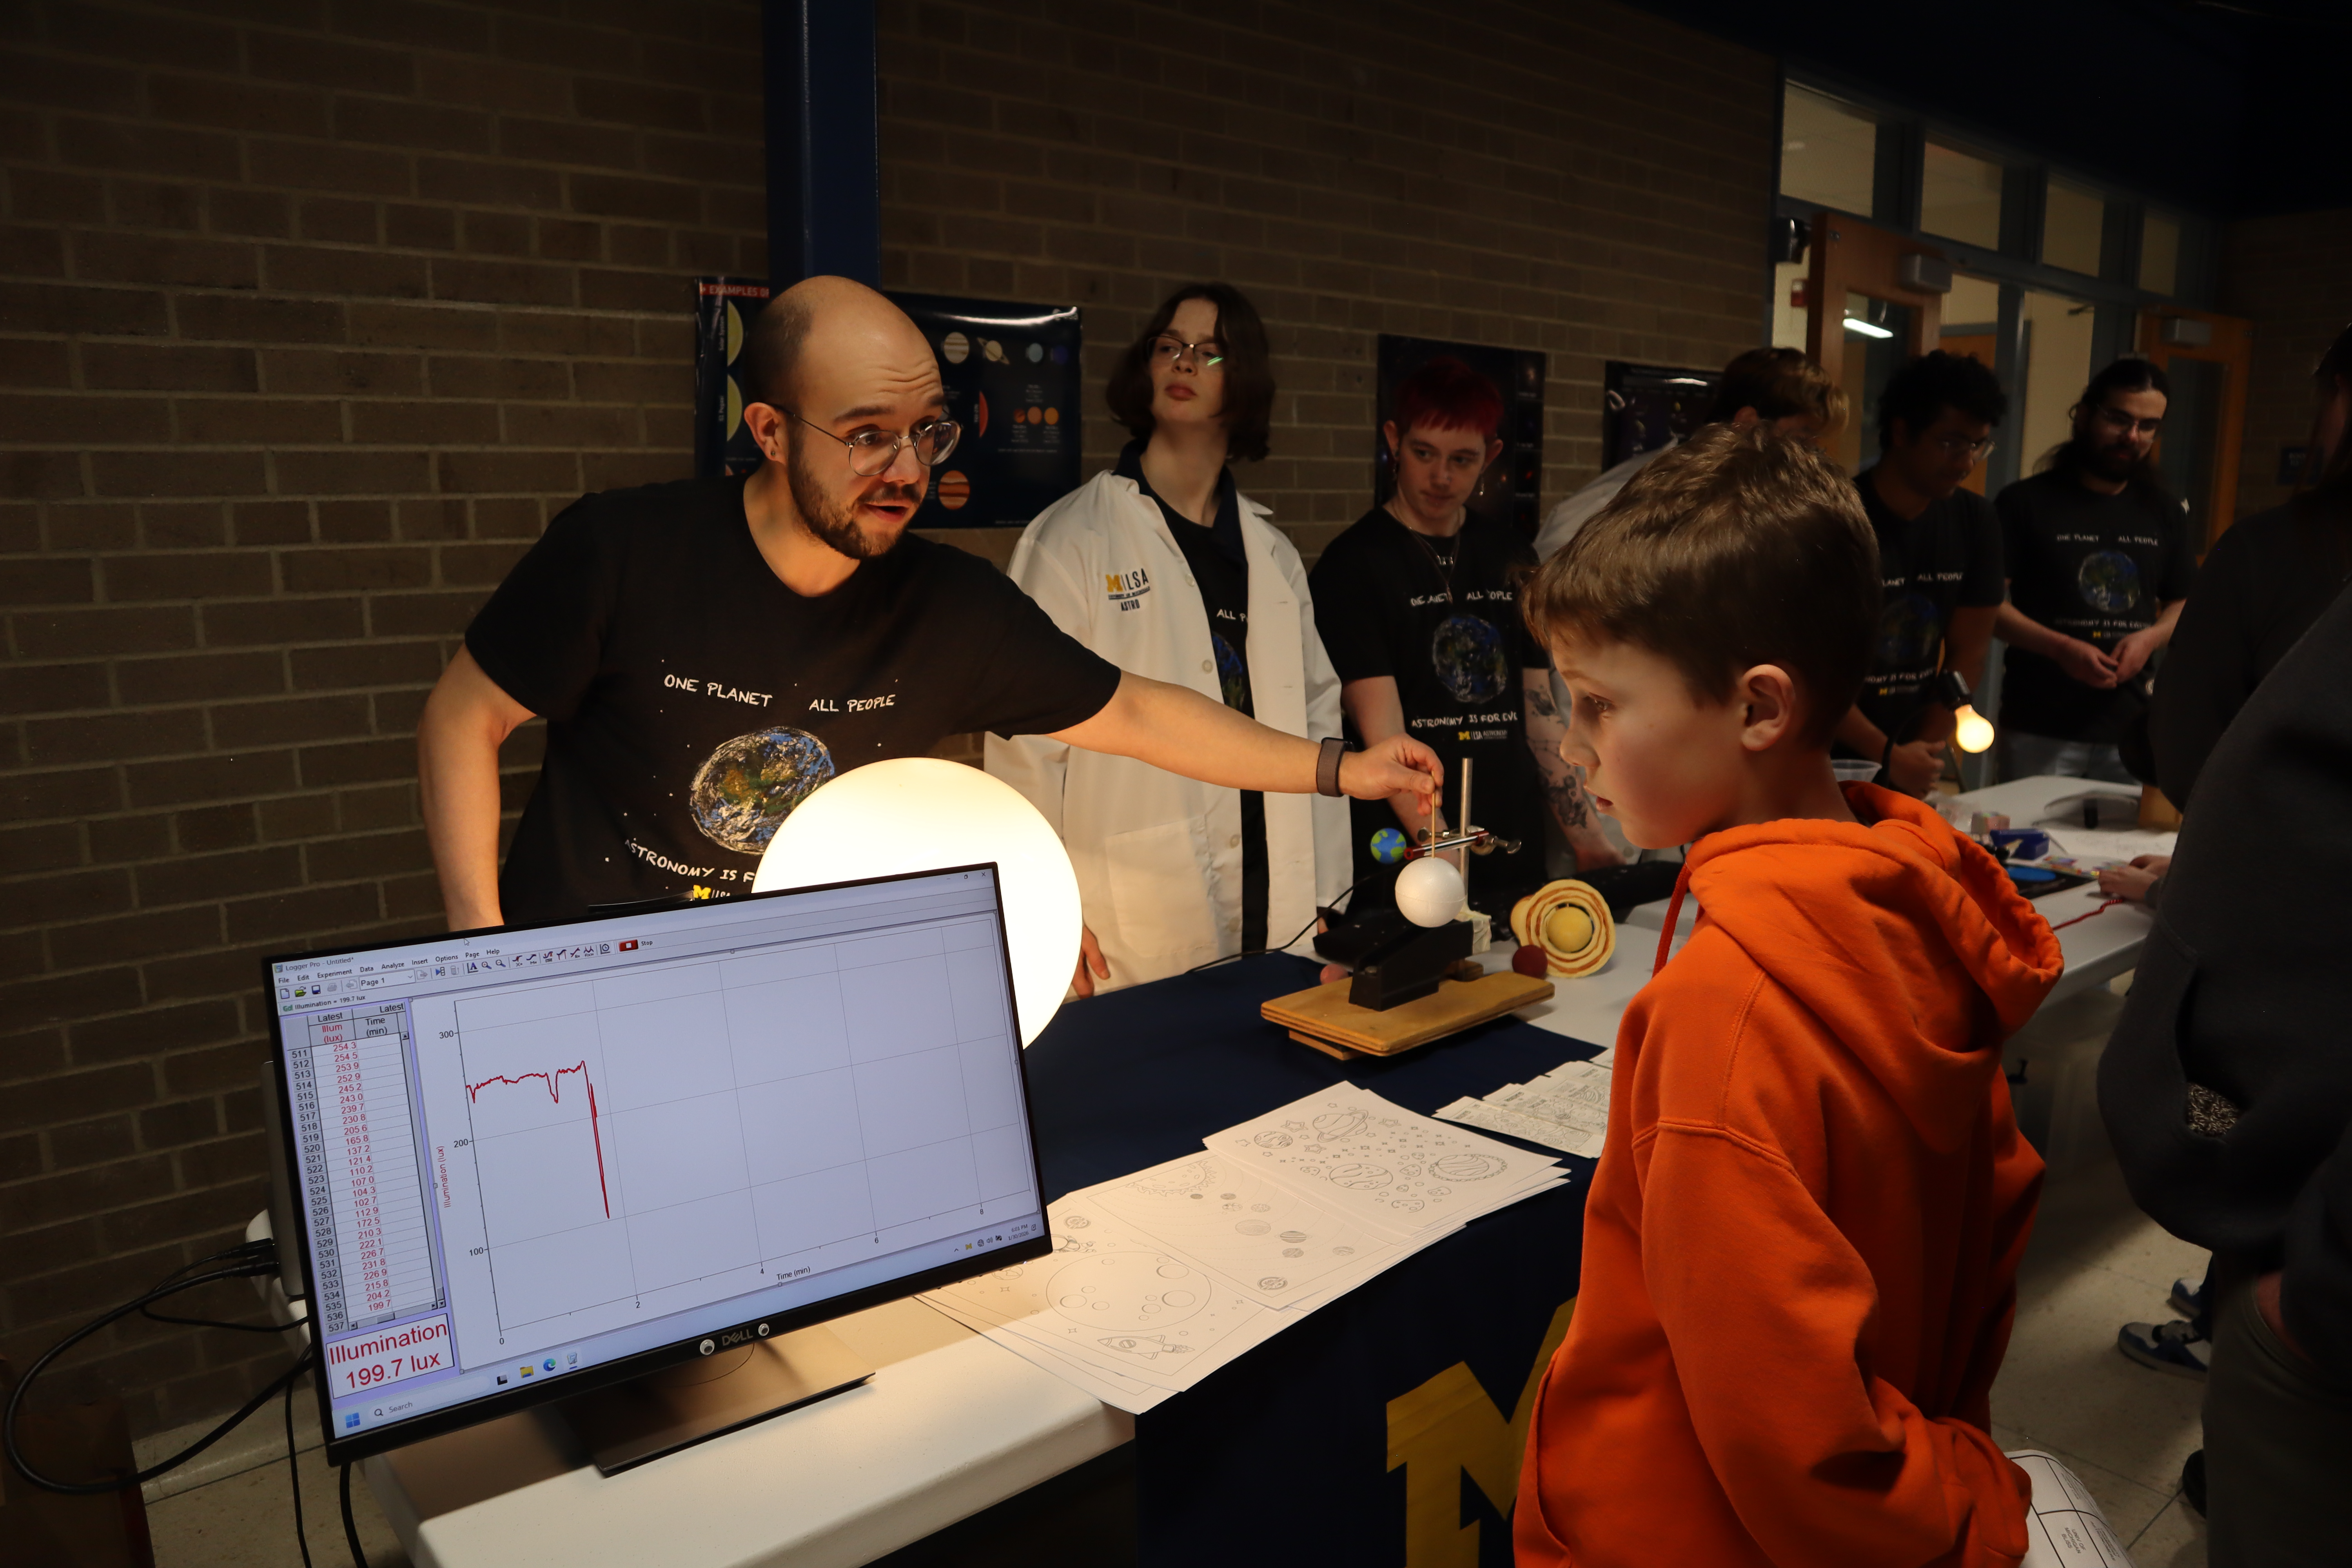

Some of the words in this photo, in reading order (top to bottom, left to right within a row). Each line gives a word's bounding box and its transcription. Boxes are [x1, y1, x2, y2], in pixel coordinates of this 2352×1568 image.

[709, 285, 758, 296] EXAMPLES
[2056, 533, 2071, 542] ONE
[2073, 533, 2100, 543] PLANET
[2118, 535, 2131, 543] ALL
[2134, 535, 2158, 546] PEOPLE
[1105, 574, 1123, 592] M
[1126, 568, 1149, 590] LSA
[1882, 577, 1906, 587] LANET
[1917, 573, 1934, 582] ALL
[1121, 599, 1140, 611] ASTRO
[1466, 590, 1484, 601] ALL
[1216, 608, 1236, 620] ALL
[2113, 619, 2127, 628] FOR
[664, 674, 699, 693] ONE
[707, 682, 773, 707] PLANET
[809, 699, 839, 712] ALL
[847, 694, 896, 712] PEOPLE
[1412, 715, 1463, 728] ASTRONOMY
[1468, 713, 1478, 724] IS
[1479, 713, 1501, 724] FOR
[1458, 730, 1471, 741] M
[1473, 730, 1483, 740] LSA
[624, 839, 715, 877] ASTRONOMY
[719, 869, 738, 881] IS
[693, 884, 712, 900] M
[317, 969, 352, 979] Experiment
[435, 955, 458, 963] Options
[295, 1000, 332, 1010] Illumination
[318, 1012, 343, 1022] Latest
[380, 1004, 404, 1013] Latest
[322, 1024, 343, 1033] Illum
[324, 1034, 343, 1044] (lux)
[366, 1027, 387, 1037] (min)
[292, 1049, 307, 1059] 511
[333, 1041, 356, 1052] 254.3
[293, 1059, 309, 1069] 512
[334, 1051, 358, 1062] 254.5
[294, 1070, 311, 1080] 513
[336, 1062, 359, 1073] 253.9
[296, 1081, 312, 1091] 514
[337, 1073, 361, 1083] 252.9
[297, 1091, 314, 1101] 515
[338, 1083, 362, 1094] 245.2
[299, 1102, 315, 1111] 516
[339, 1093, 363, 1104] 243.0
[300, 1112, 316, 1122] 517
[341, 1103, 364, 1114] 239.7
[301, 1122, 318, 1132] 518
[342, 1113, 366, 1125] 230.8
[303, 1133, 319, 1143] 519
[344, 1124, 367, 1136] 205.6
[304, 1143, 321, 1153] 520
[346, 1134, 369, 1145] 165.8
[454, 1139, 468, 1148] 200
[305, 1154, 321, 1164] 521
[347, 1145, 370, 1156] 137.2
[436, 1145, 445, 1162] (lux)
[307, 1164, 323, 1174] 522
[348, 1155, 371, 1166] 121.4
[308, 1174, 325, 1185] 523
[350, 1165, 373, 1176] 110.2
[310, 1185, 326, 1196] 524
[351, 1176, 374, 1187] 107.0
[439, 1163, 451, 1208] Illumination
[311, 1196, 328, 1206] 525
[353, 1186, 376, 1197] 104.3
[312, 1206, 329, 1216] 526
[354, 1196, 377, 1207] 102.7
[314, 1216, 330, 1227] 527
[356, 1206, 379, 1218] 112.9
[315, 1227, 332, 1238] 528
[357, 1216, 380, 1228] 172.5
[317, 1238, 333, 1249] 529
[358, 1227, 381, 1240] 210.3
[318, 1248, 334, 1259] 530
[359, 1238, 381, 1250] 222.1
[319, 1259, 335, 1269] 531
[361, 1247, 384, 1260] 226.7
[470, 1247, 484, 1256] 100
[321, 1269, 338, 1279] 532
[362, 1258, 386, 1270] 231.8
[776, 1272, 793, 1281] Time
[794, 1266, 811, 1277] (min)
[323, 1279, 339, 1290] 533
[363, 1268, 387, 1281] 226.9
[324, 1290, 340, 1301] 534
[365, 1279, 388, 1291] 215.8
[325, 1300, 342, 1311] 535
[367, 1289, 390, 1301] 204.2
[327, 1311, 343, 1322] 536
[368, 1299, 391, 1311] 199.7
[328, 1321, 344, 1332] 537
[330, 1323, 447, 1365] Illumination
[722, 1329, 753, 1346] DELL
[346, 1358, 403, 1389] 199.7
[411, 1353, 441, 1372] lux
[389, 1401, 413, 1413] Search
[1386, 1296, 1577, 1568] M
[2062, 1534, 2073, 1549] BLISS
[2064, 1527, 2082, 1553] MICHIGAN
[2072, 1529, 2082, 1542] UNIV
[2079, 1543, 2086, 1551] OF
